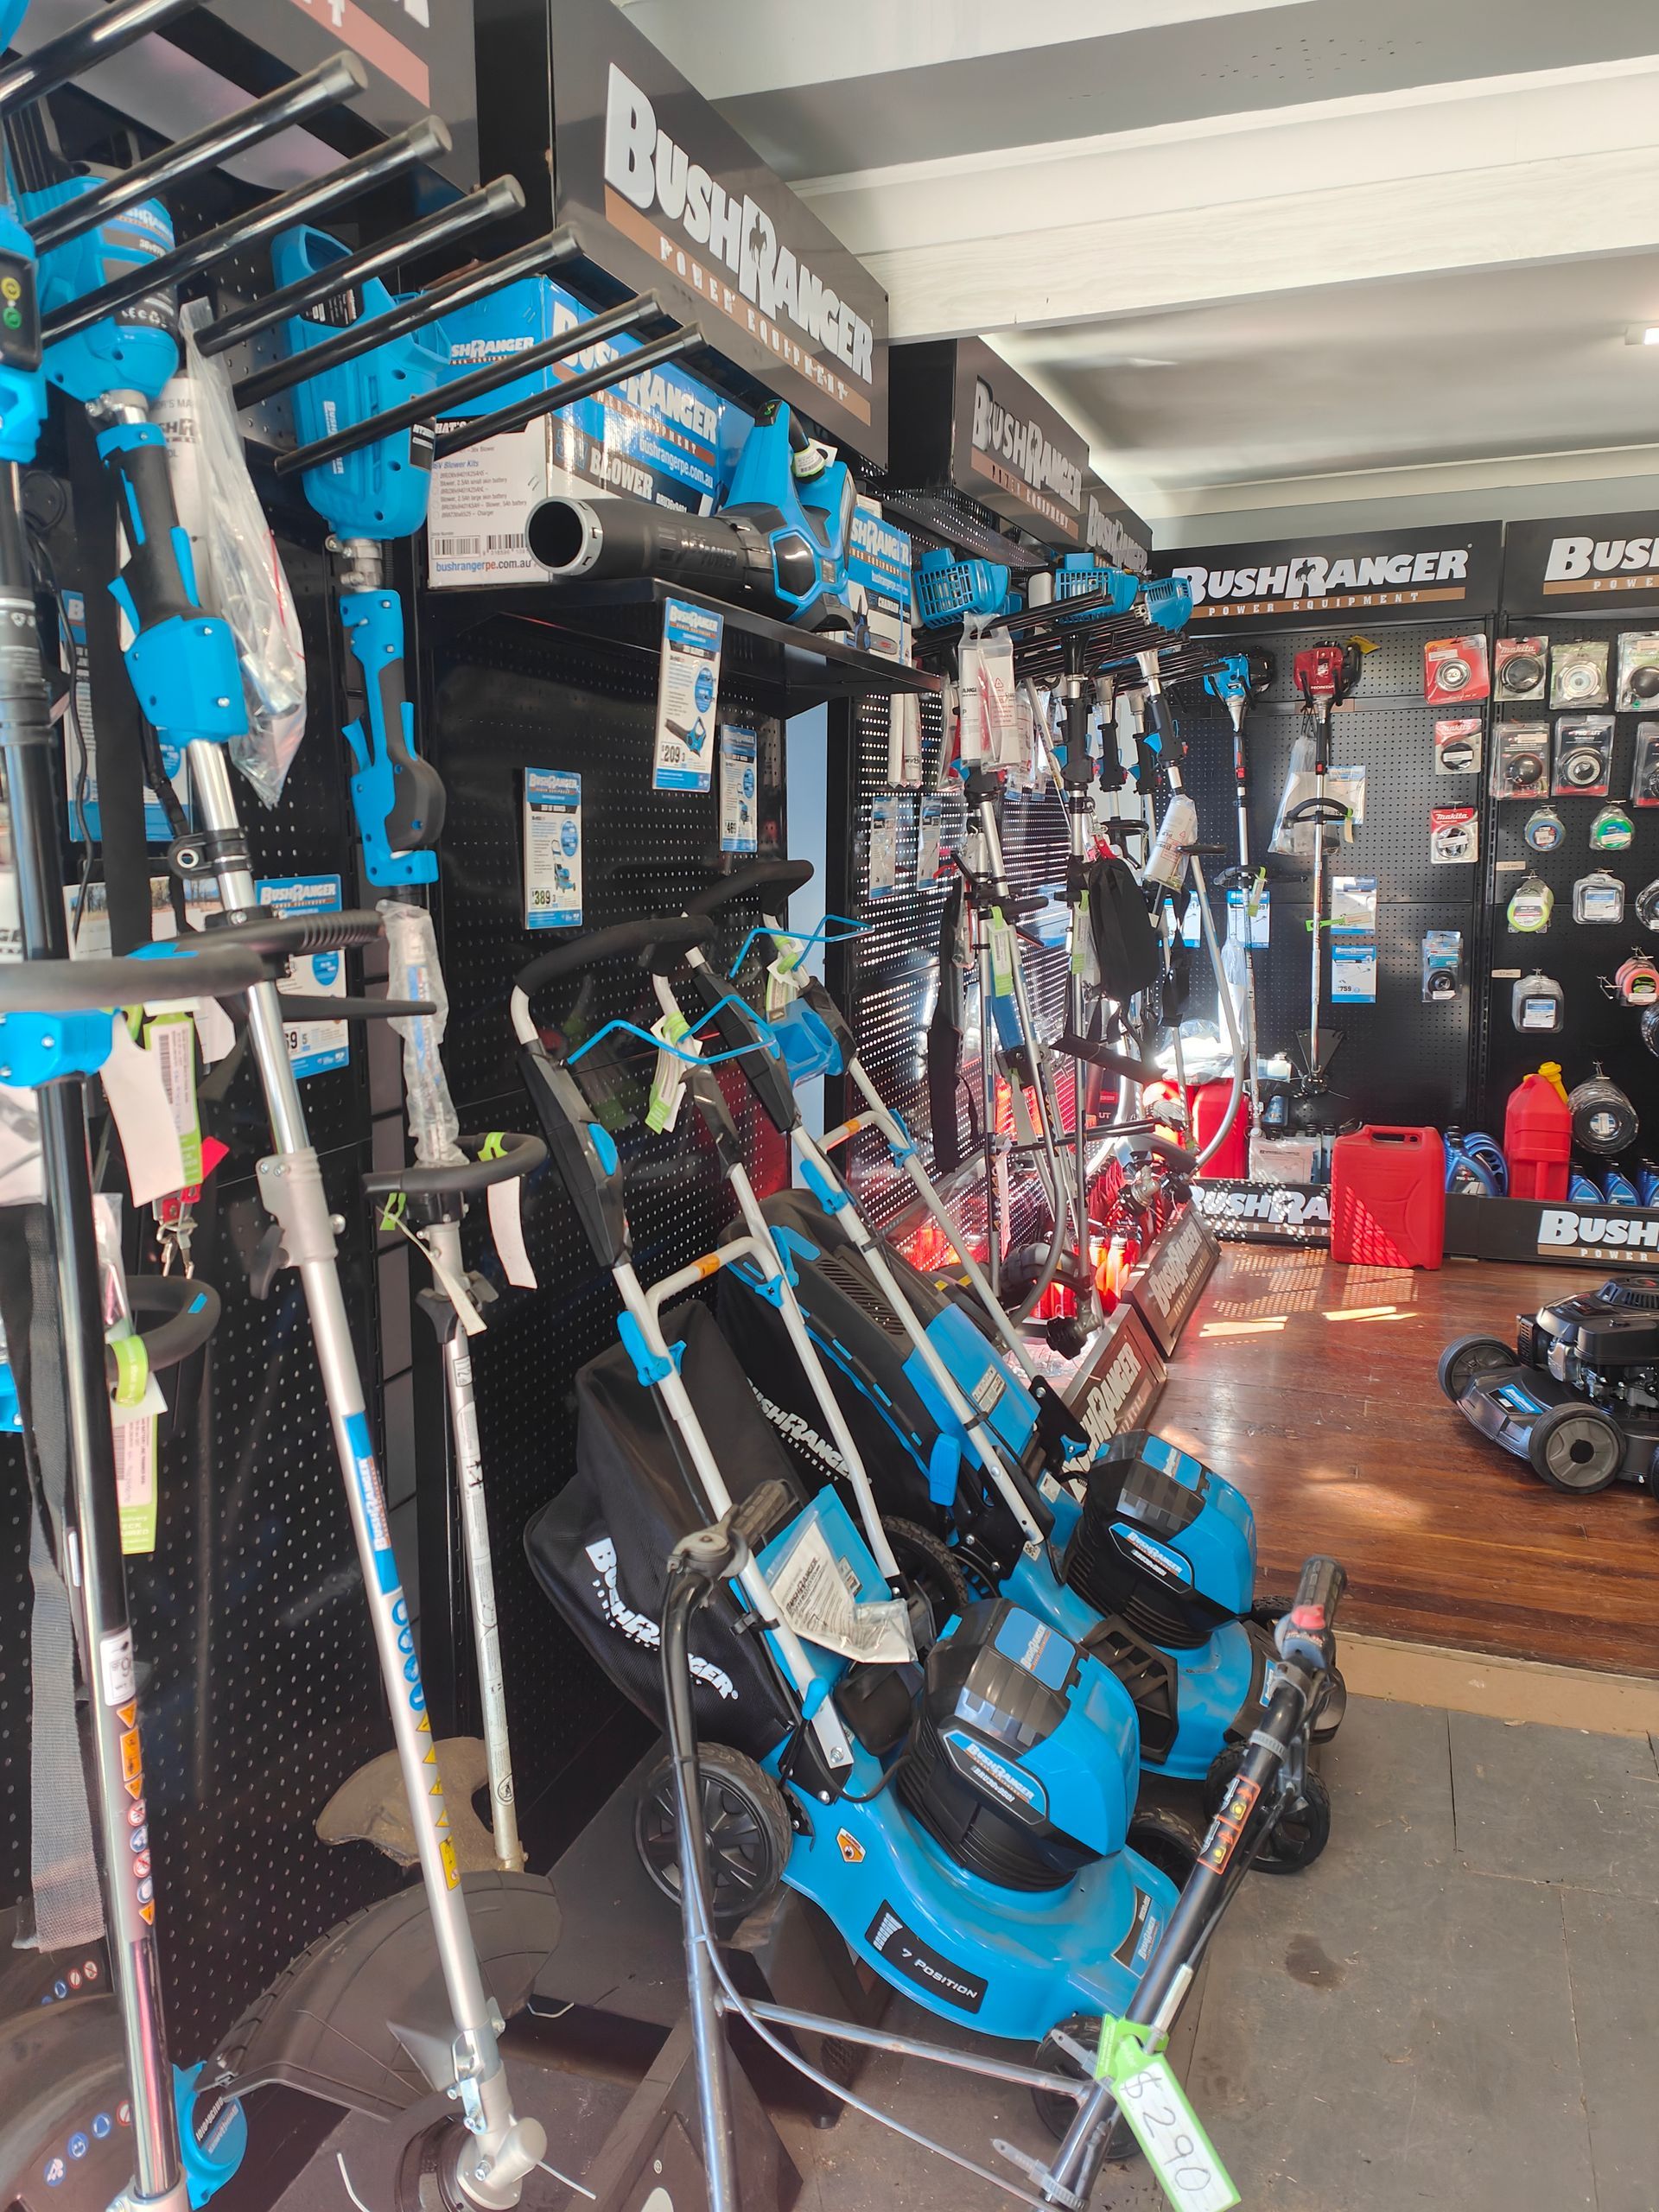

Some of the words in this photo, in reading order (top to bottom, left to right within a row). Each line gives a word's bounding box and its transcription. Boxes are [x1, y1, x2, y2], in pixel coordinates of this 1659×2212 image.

[607, 62, 873, 385] BUSHRANGER
[660, 236, 735, 315] POWER
[747, 305, 849, 399] EQUIPMENT
[451, 336, 534, 359] SHRANGER
[972, 379, 1082, 512] BUSHRANGER
[590, 447, 654, 501] BLOWER
[435, 560, 531, 572] bushrangerpe.com.au
[1170, 548, 1469, 607] BUSHRANGER
[1592, 576, 1654, 591] POWE
[1209, 603, 1275, 617] POWER
[1293, 591, 1421, 611] EQUIPMENT
[261, 883, 337, 906] BUSHRANGER
[1148, 1220, 1203, 1318] BUSHRANGER
[1580, 1248, 1649, 1262] POWER
[965, 1742, 1035, 1801] BUSHRANGER
[901, 1947, 912, 1959] 7
[913, 1958, 978, 1999] POSITION
[1120, 2070, 1211, 2192] $290
